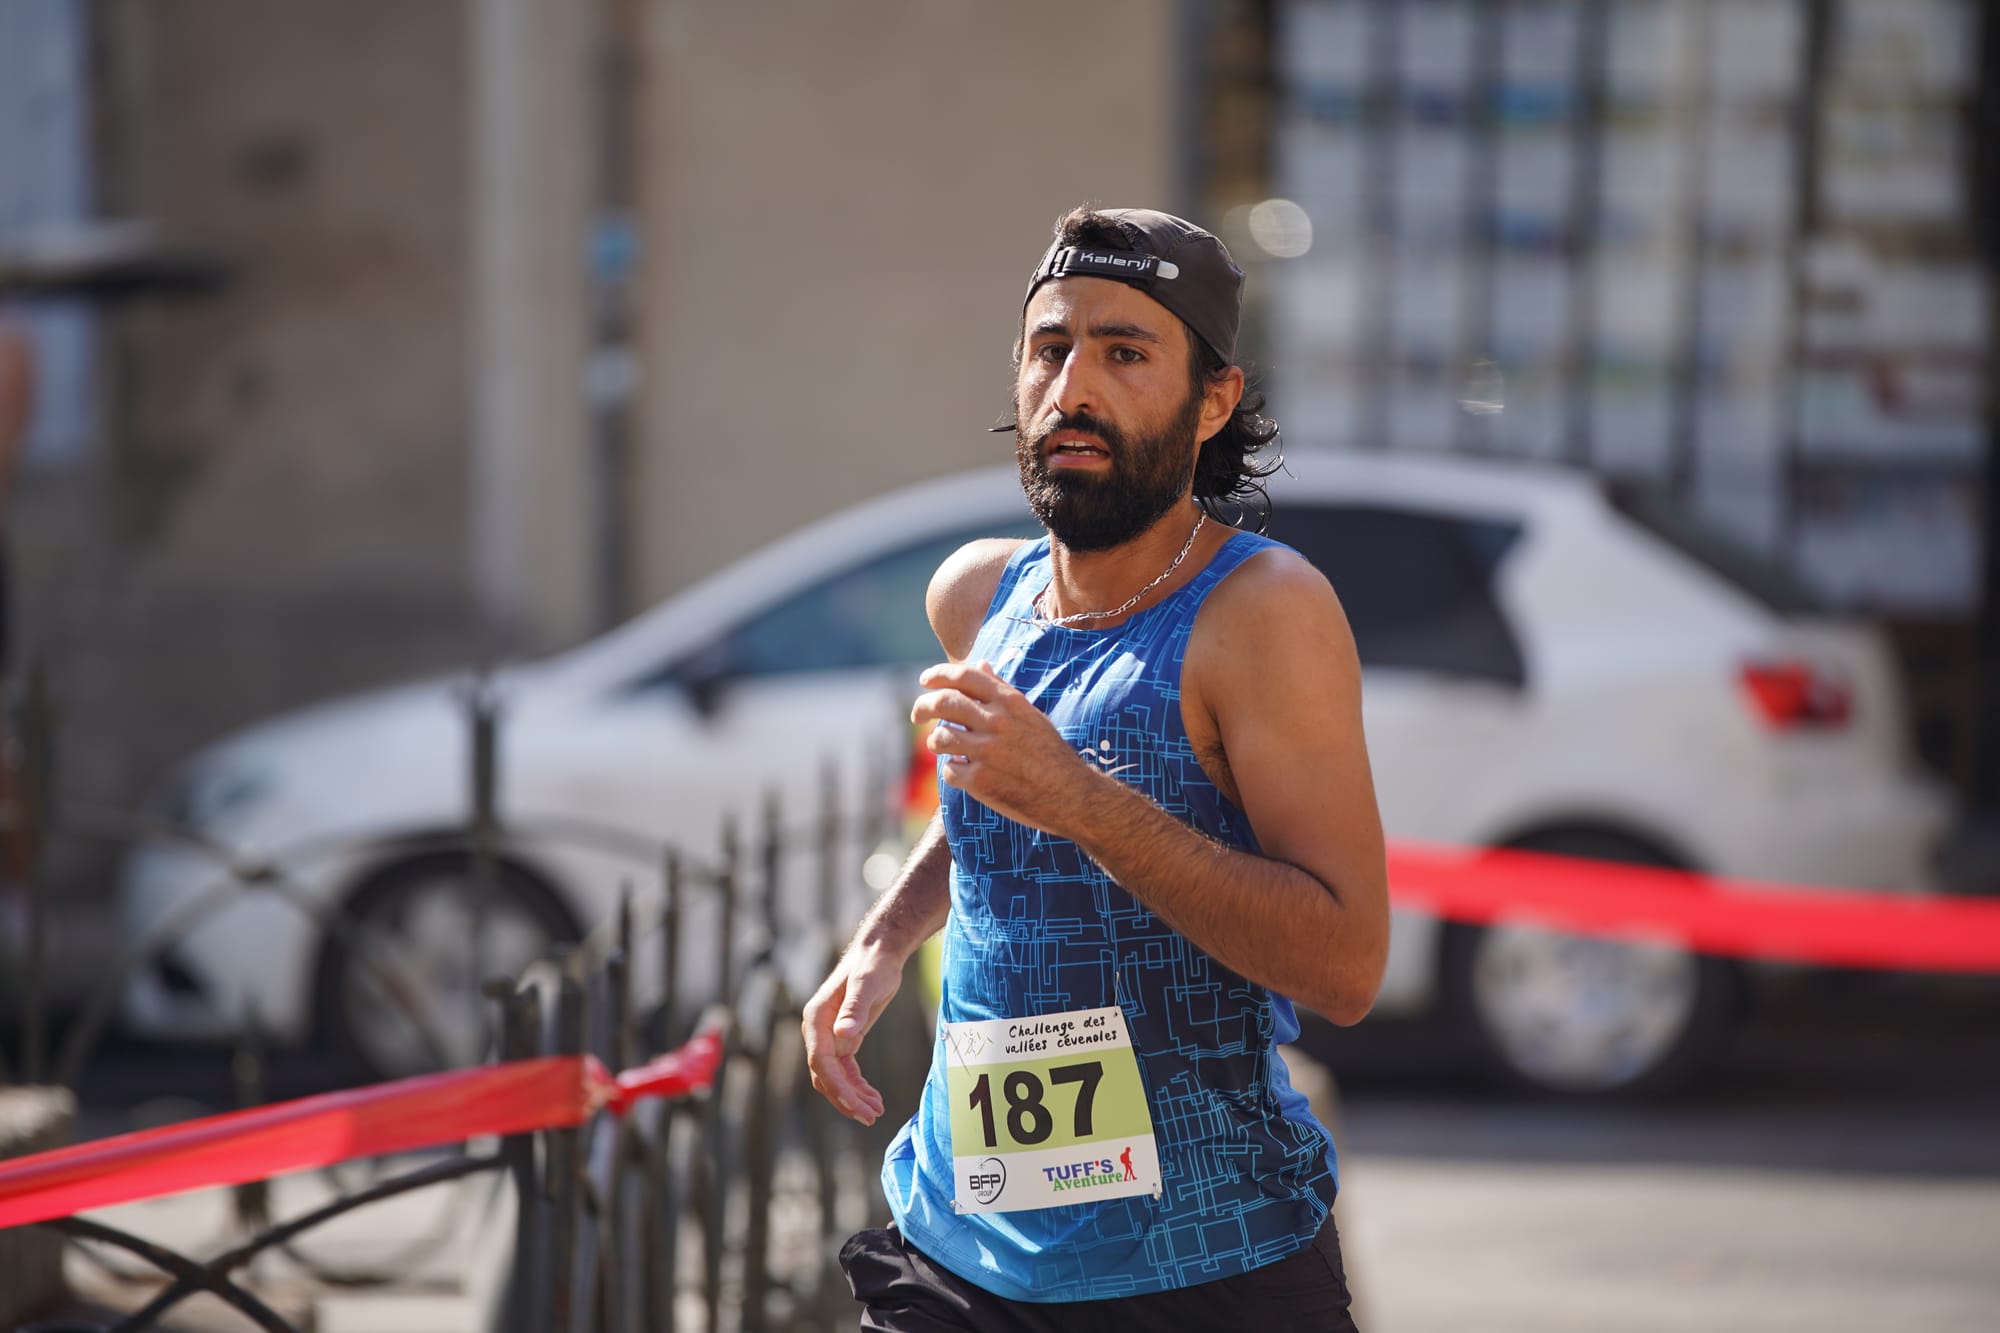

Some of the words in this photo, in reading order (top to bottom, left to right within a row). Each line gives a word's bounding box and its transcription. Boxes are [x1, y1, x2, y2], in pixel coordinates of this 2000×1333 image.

[1080, 252, 1152, 270] Kalenji
[1008, 1020, 1075, 1039] Challenge
[1083, 1016, 1106, 1029] des
[1005, 1039, 1048, 1055] vallées
[1057, 1030, 1118, 1048] cévenoles
[969, 1061, 1104, 1148] 187
[969, 1173, 1001, 1190] BFP
[1042, 1159, 1114, 1182] TUFF'S
[1052, 1171, 1123, 1192] Aventure
